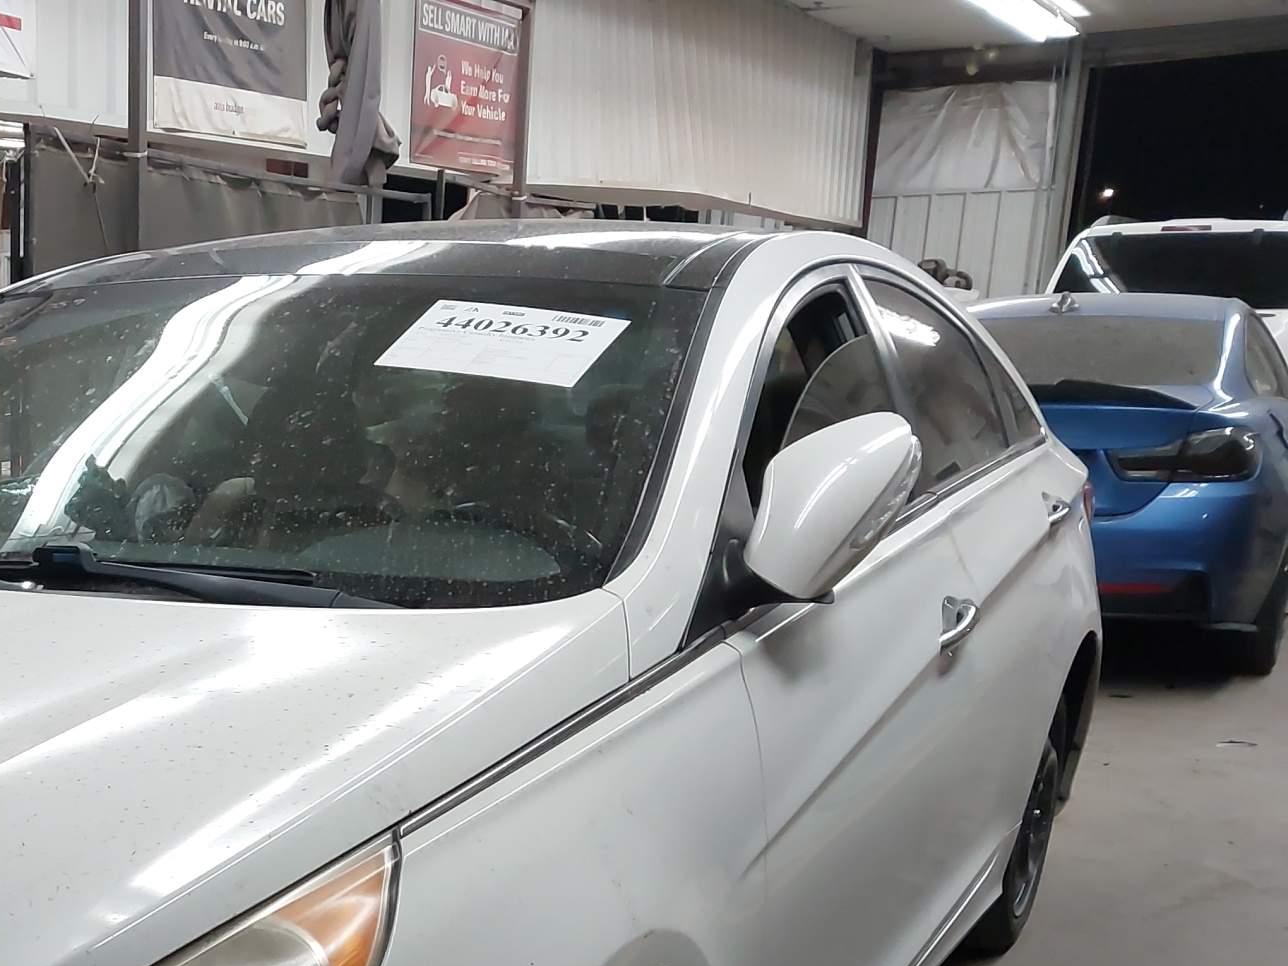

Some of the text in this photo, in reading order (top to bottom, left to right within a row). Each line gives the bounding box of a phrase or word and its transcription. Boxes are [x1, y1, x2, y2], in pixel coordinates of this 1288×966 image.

[246, 0, 285, 26] CARS
[422, 3, 444, 30] SELL
[444, 10, 477, 39] SMART
[477, 20, 501, 47] WITH
[460, 80, 478, 97] Earn
[461, 100, 506, 121] Your Vehicle
[436, 315, 590, 343] 44026392
